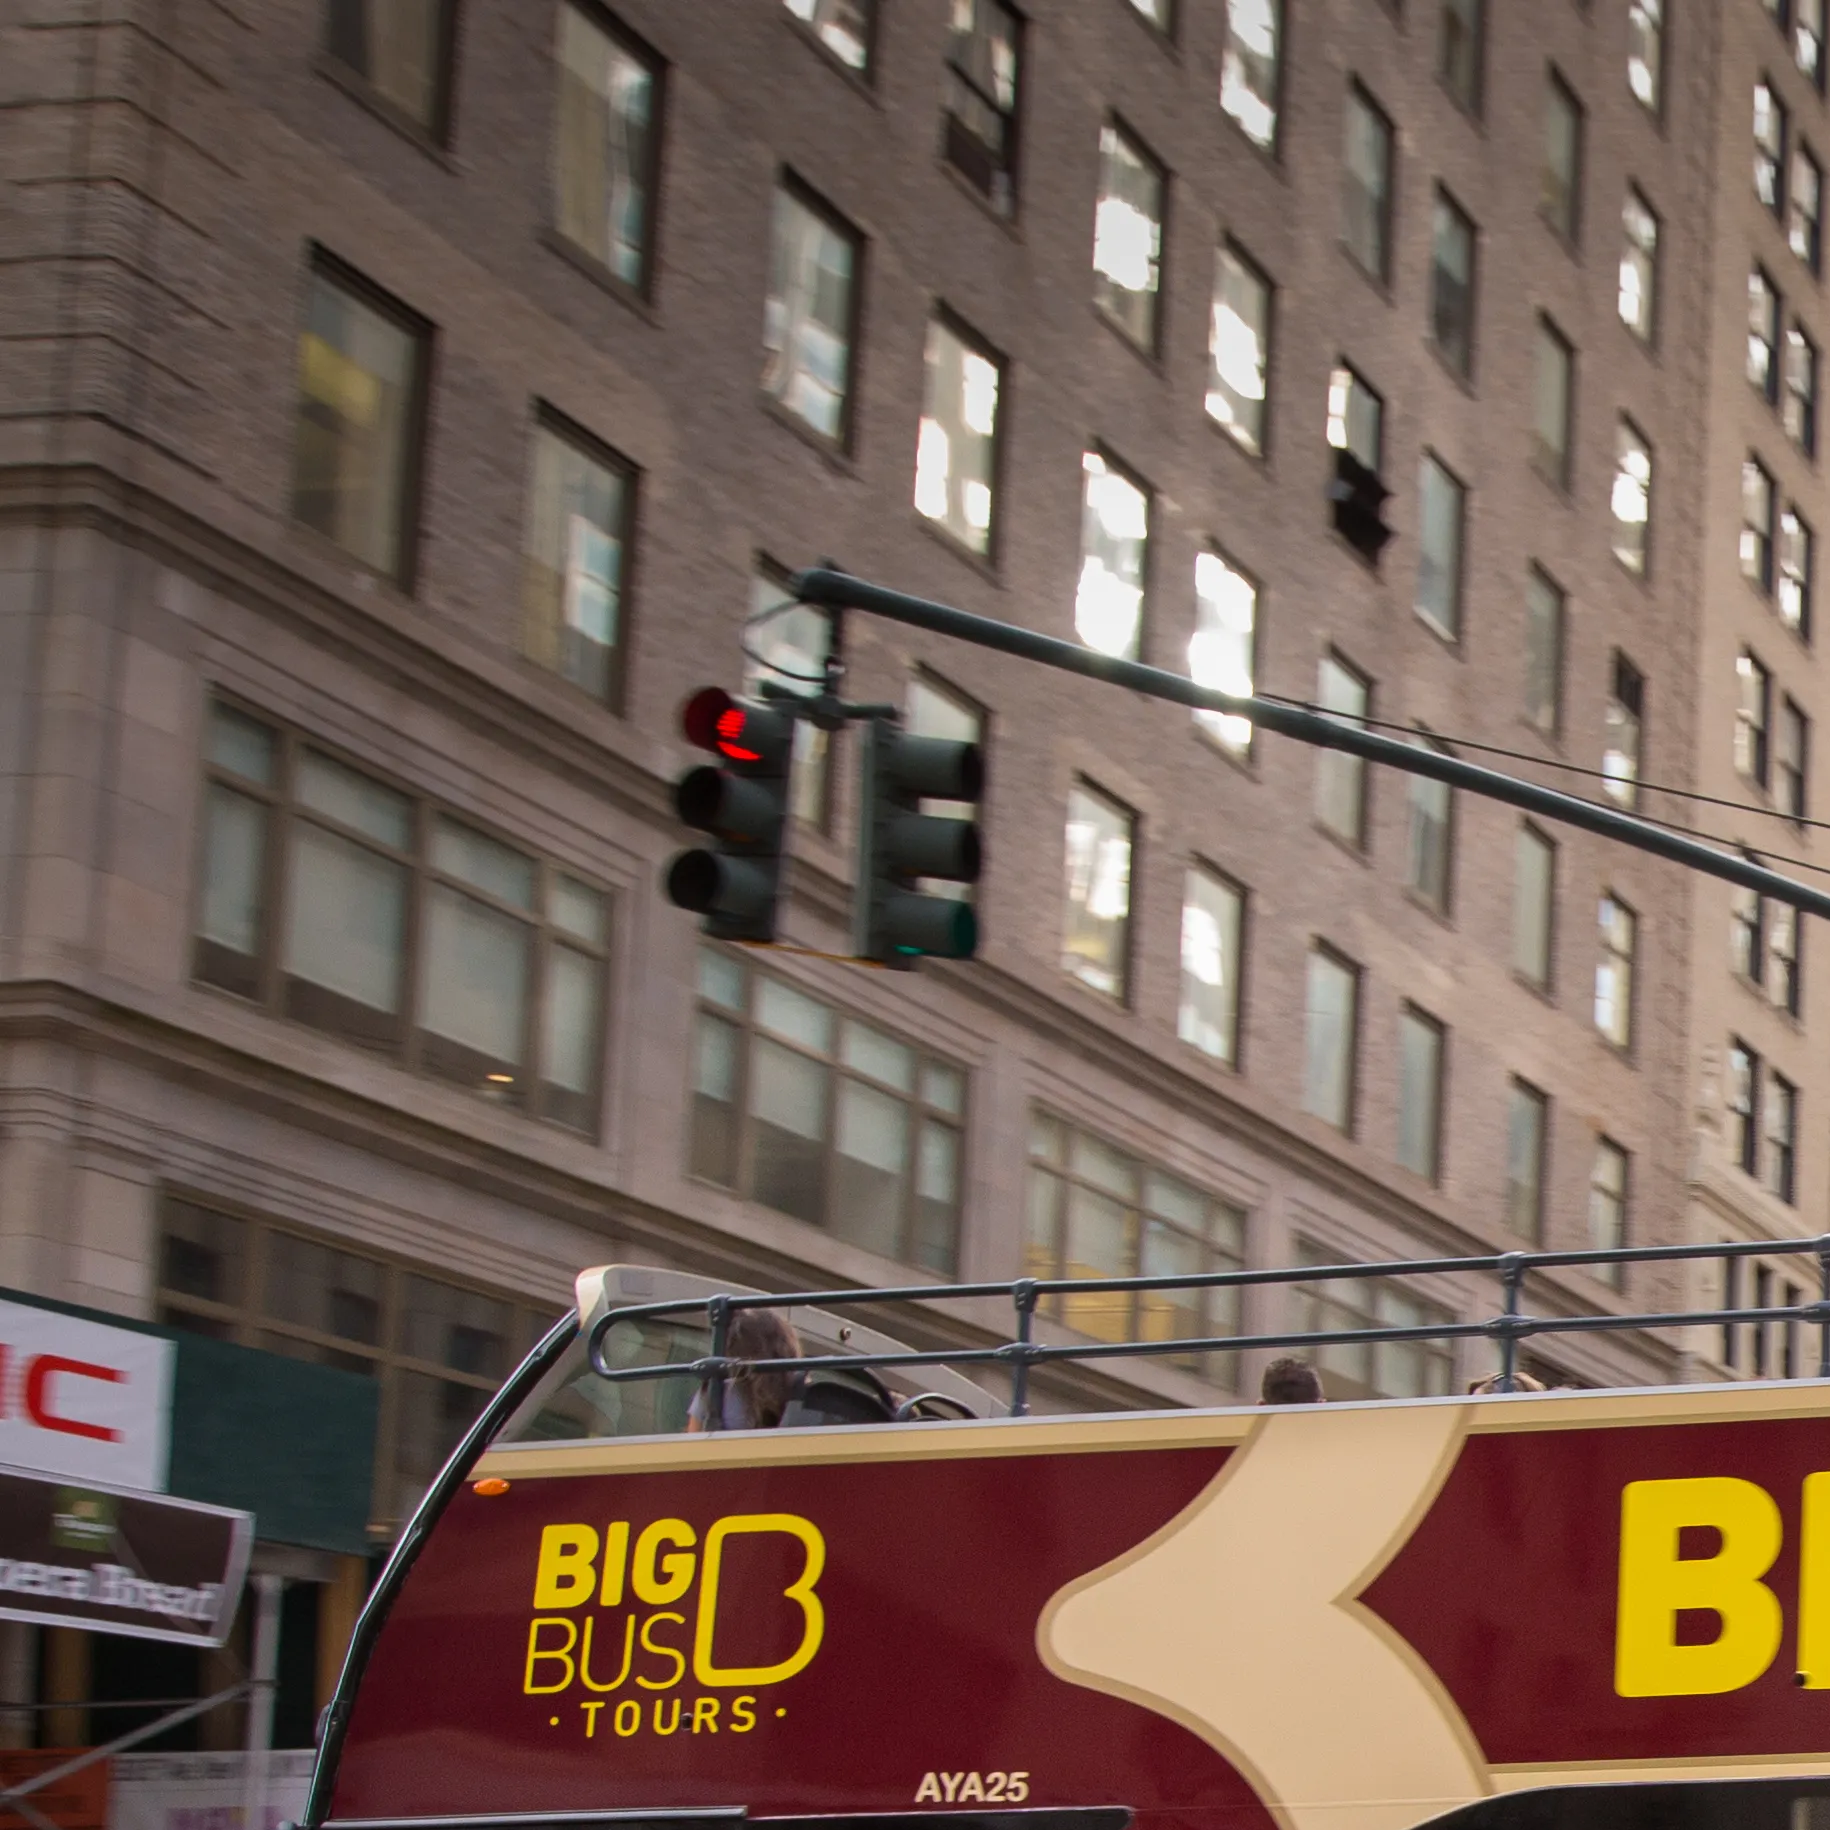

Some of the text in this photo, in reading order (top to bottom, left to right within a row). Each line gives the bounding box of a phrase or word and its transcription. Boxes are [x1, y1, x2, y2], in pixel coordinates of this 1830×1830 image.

[534, 1518, 697, 1610] BIG
[523, 1612, 687, 1696] BUS
[580, 1697, 758, 1740] TOURS
[914, 1771, 1031, 1803] AYA25
